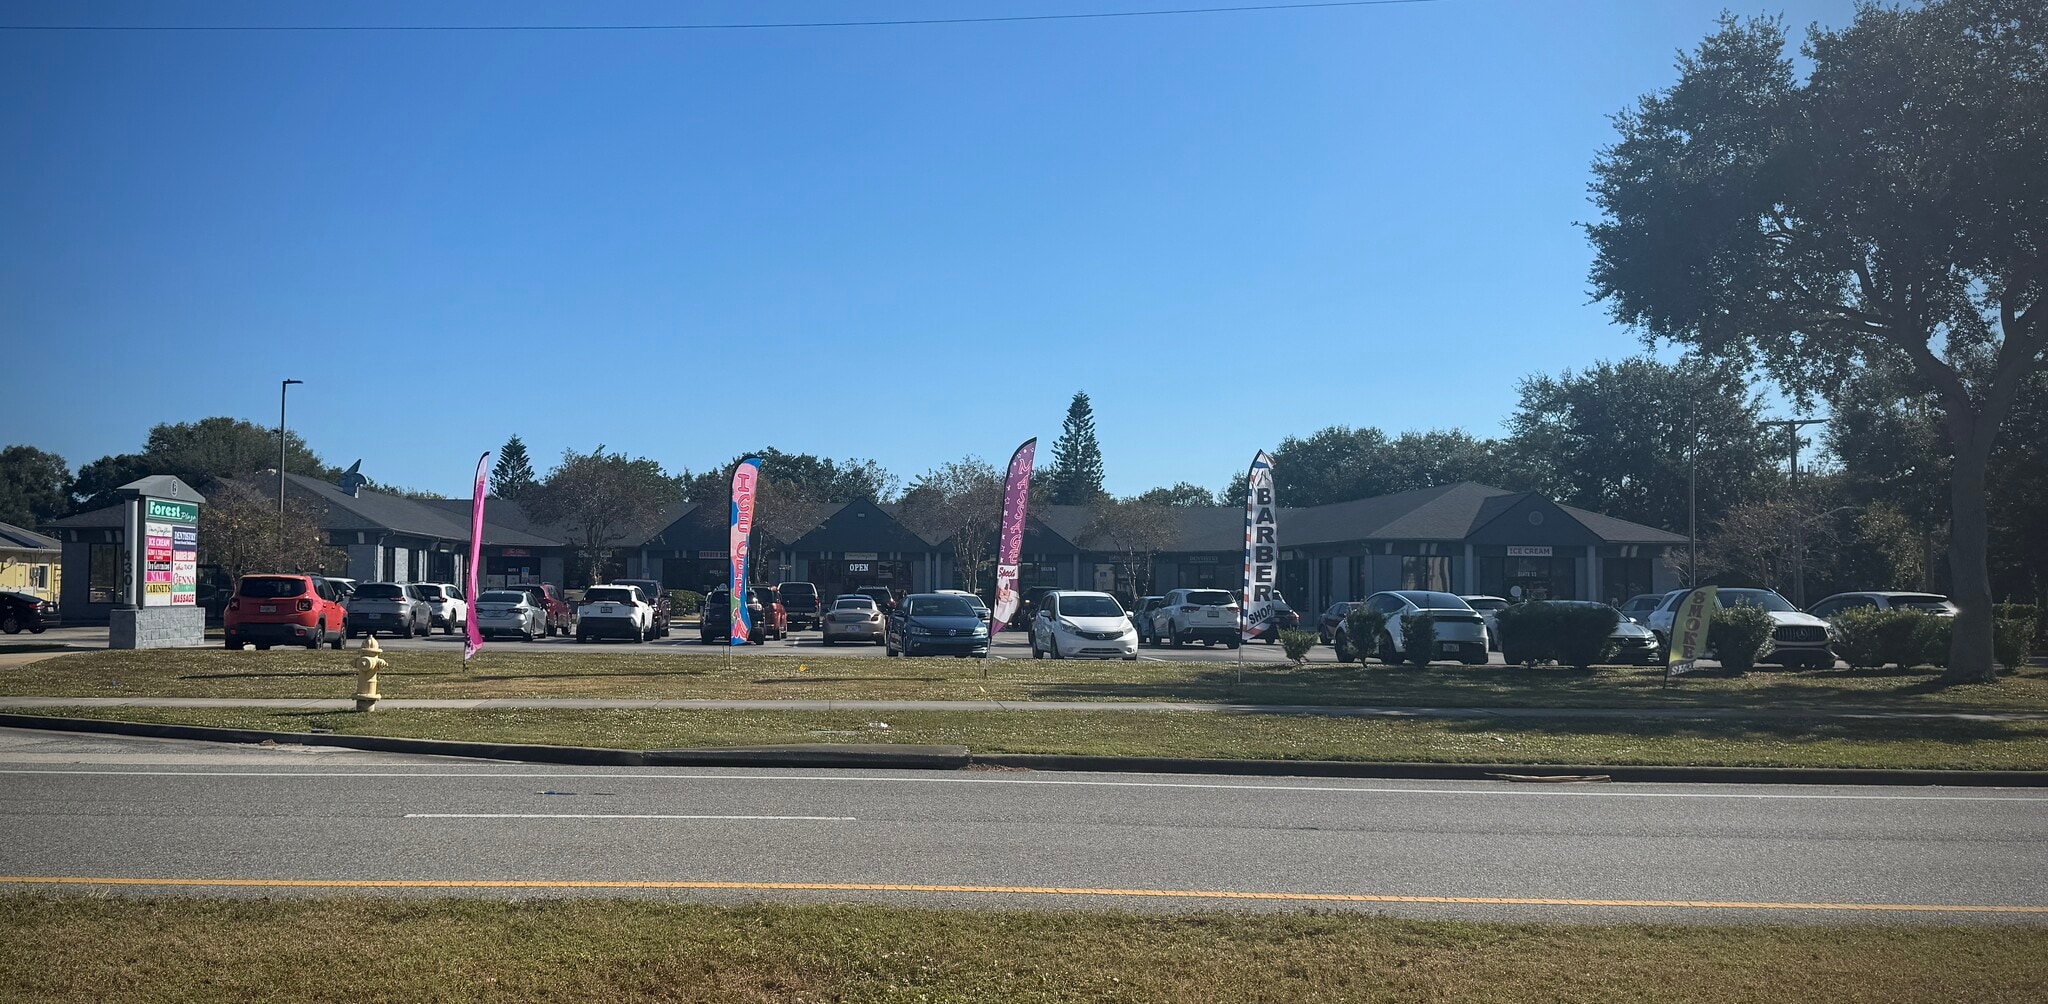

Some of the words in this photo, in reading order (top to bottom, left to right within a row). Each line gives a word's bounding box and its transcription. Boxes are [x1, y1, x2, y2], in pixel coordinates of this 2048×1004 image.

[149, 501, 181, 518] Forest
[1008, 459, 1032, 565] MASSAGE
[148, 537, 156, 546] ICE
[156, 538, 170, 547] CREAM
[1252, 487, 1275, 602] BARBER
[1509, 547, 1523, 555] ICE
[1524, 547, 1550, 555] CREAM
[849, 563, 869, 572] OPEN
[146, 584, 171, 594] CABINETS
[173, 594, 195, 603] MASSAGE
[1248, 604, 1272, 625] SHOP
[1682, 590, 1706, 659] SMOKE
